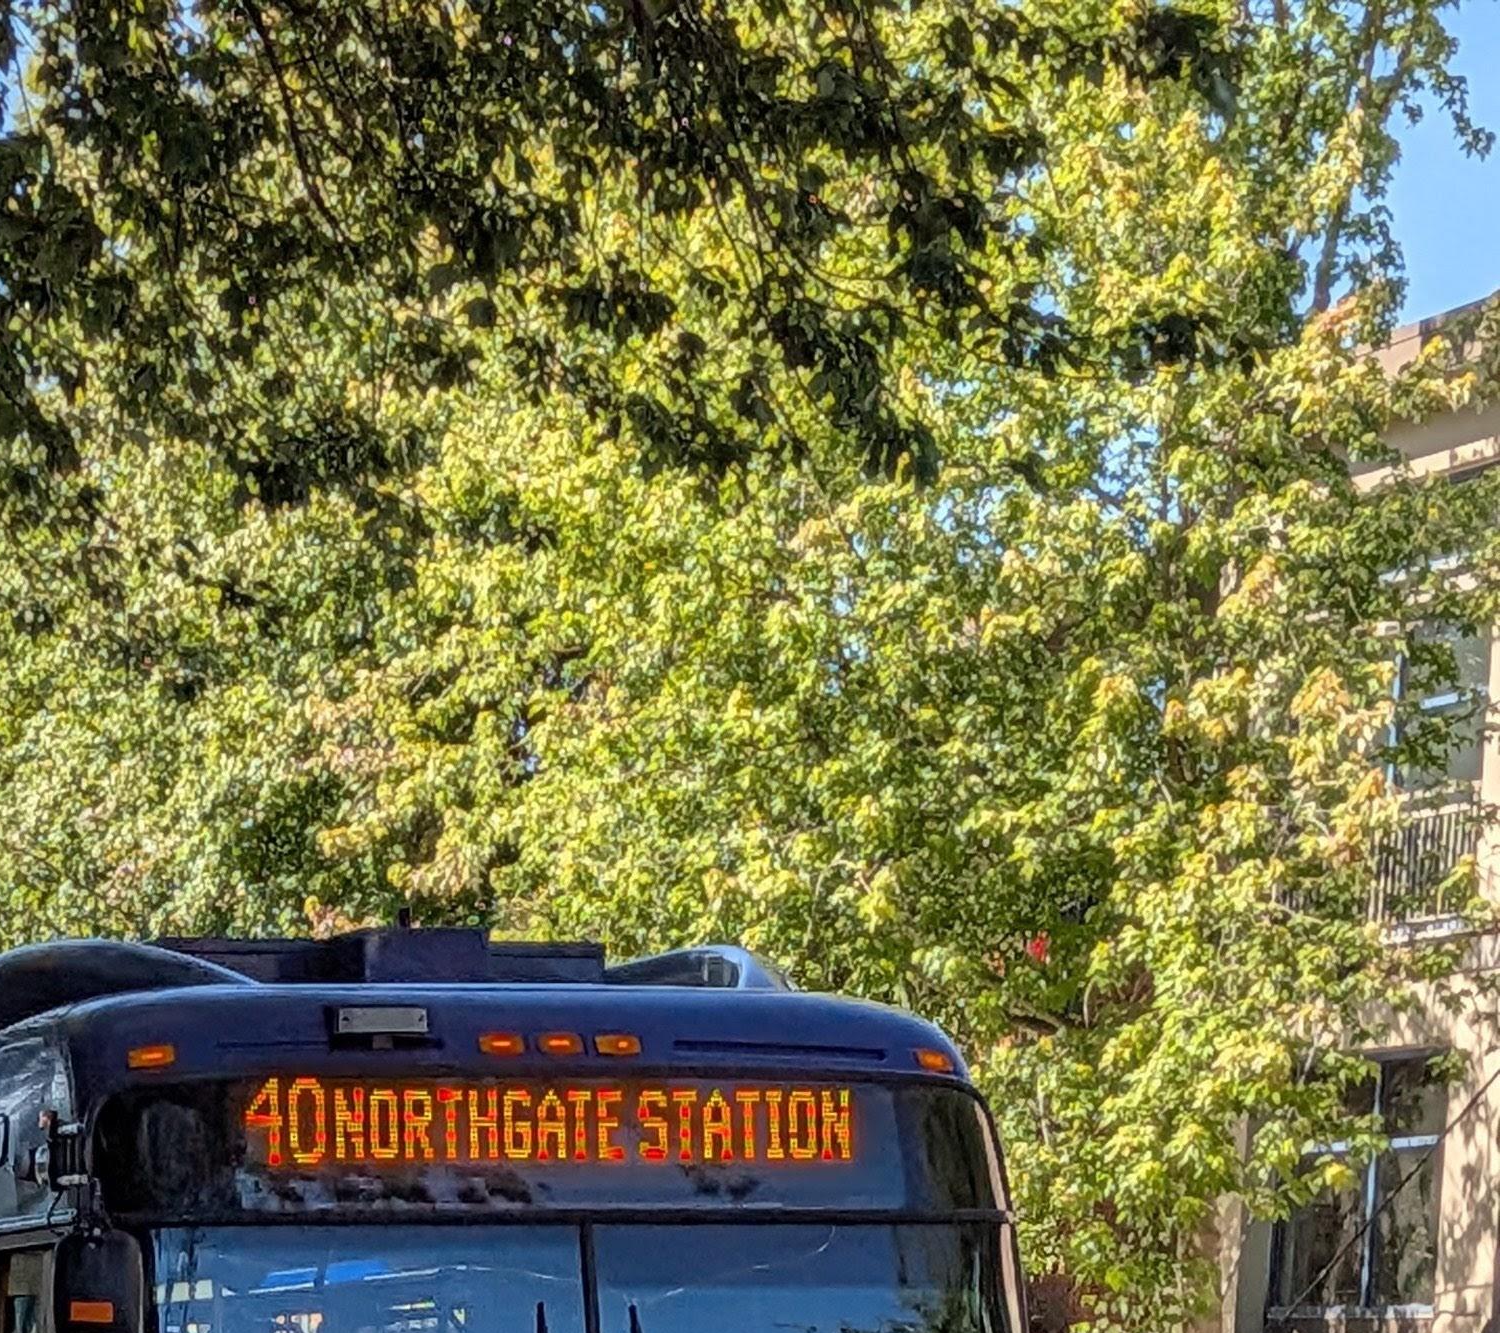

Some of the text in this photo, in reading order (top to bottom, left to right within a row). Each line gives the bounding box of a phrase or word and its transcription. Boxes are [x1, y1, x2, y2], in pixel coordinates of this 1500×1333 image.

[245, 1077, 852, 1164] 40 NORTHGATE STATION
